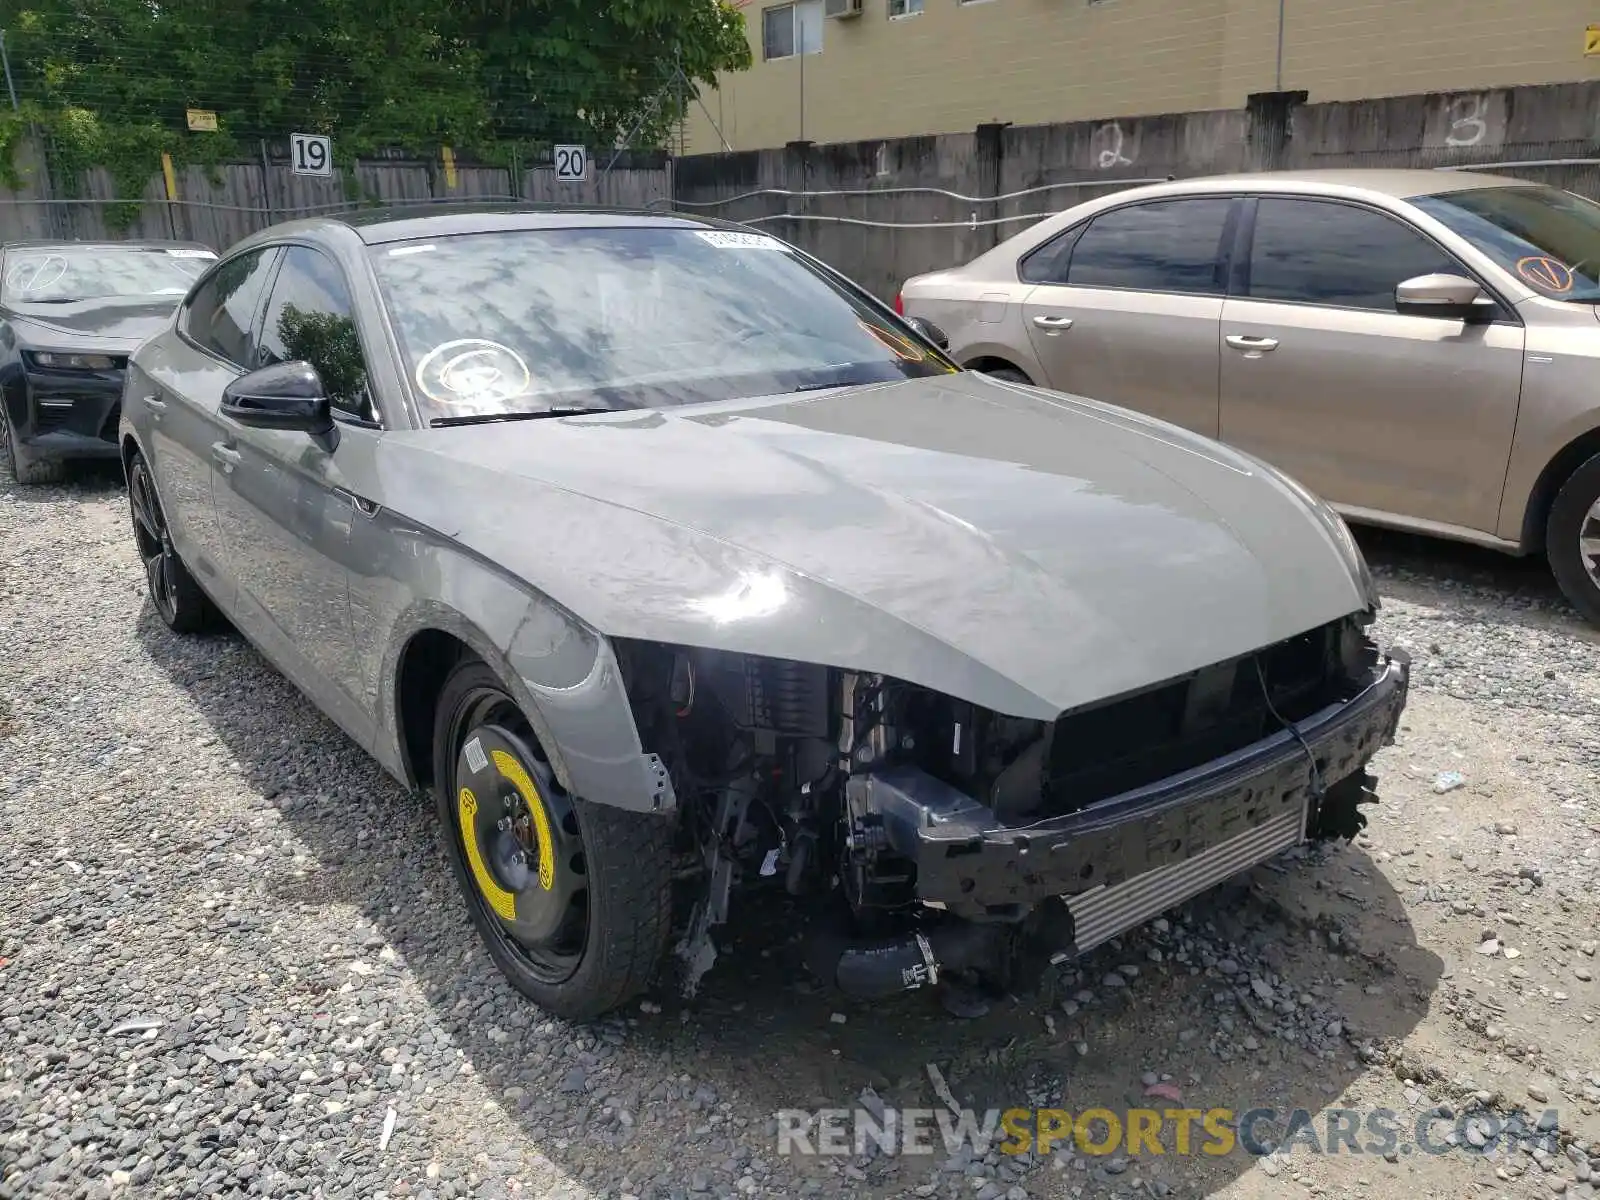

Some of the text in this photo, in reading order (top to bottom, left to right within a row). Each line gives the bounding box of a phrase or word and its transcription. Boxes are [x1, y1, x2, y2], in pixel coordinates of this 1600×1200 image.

[1445, 96, 1486, 146] 3
[295, 139, 326, 170] 19
[558, 149, 583, 176] 20
[875, 142, 890, 176] 1
[1098, 123, 1132, 168] 2
